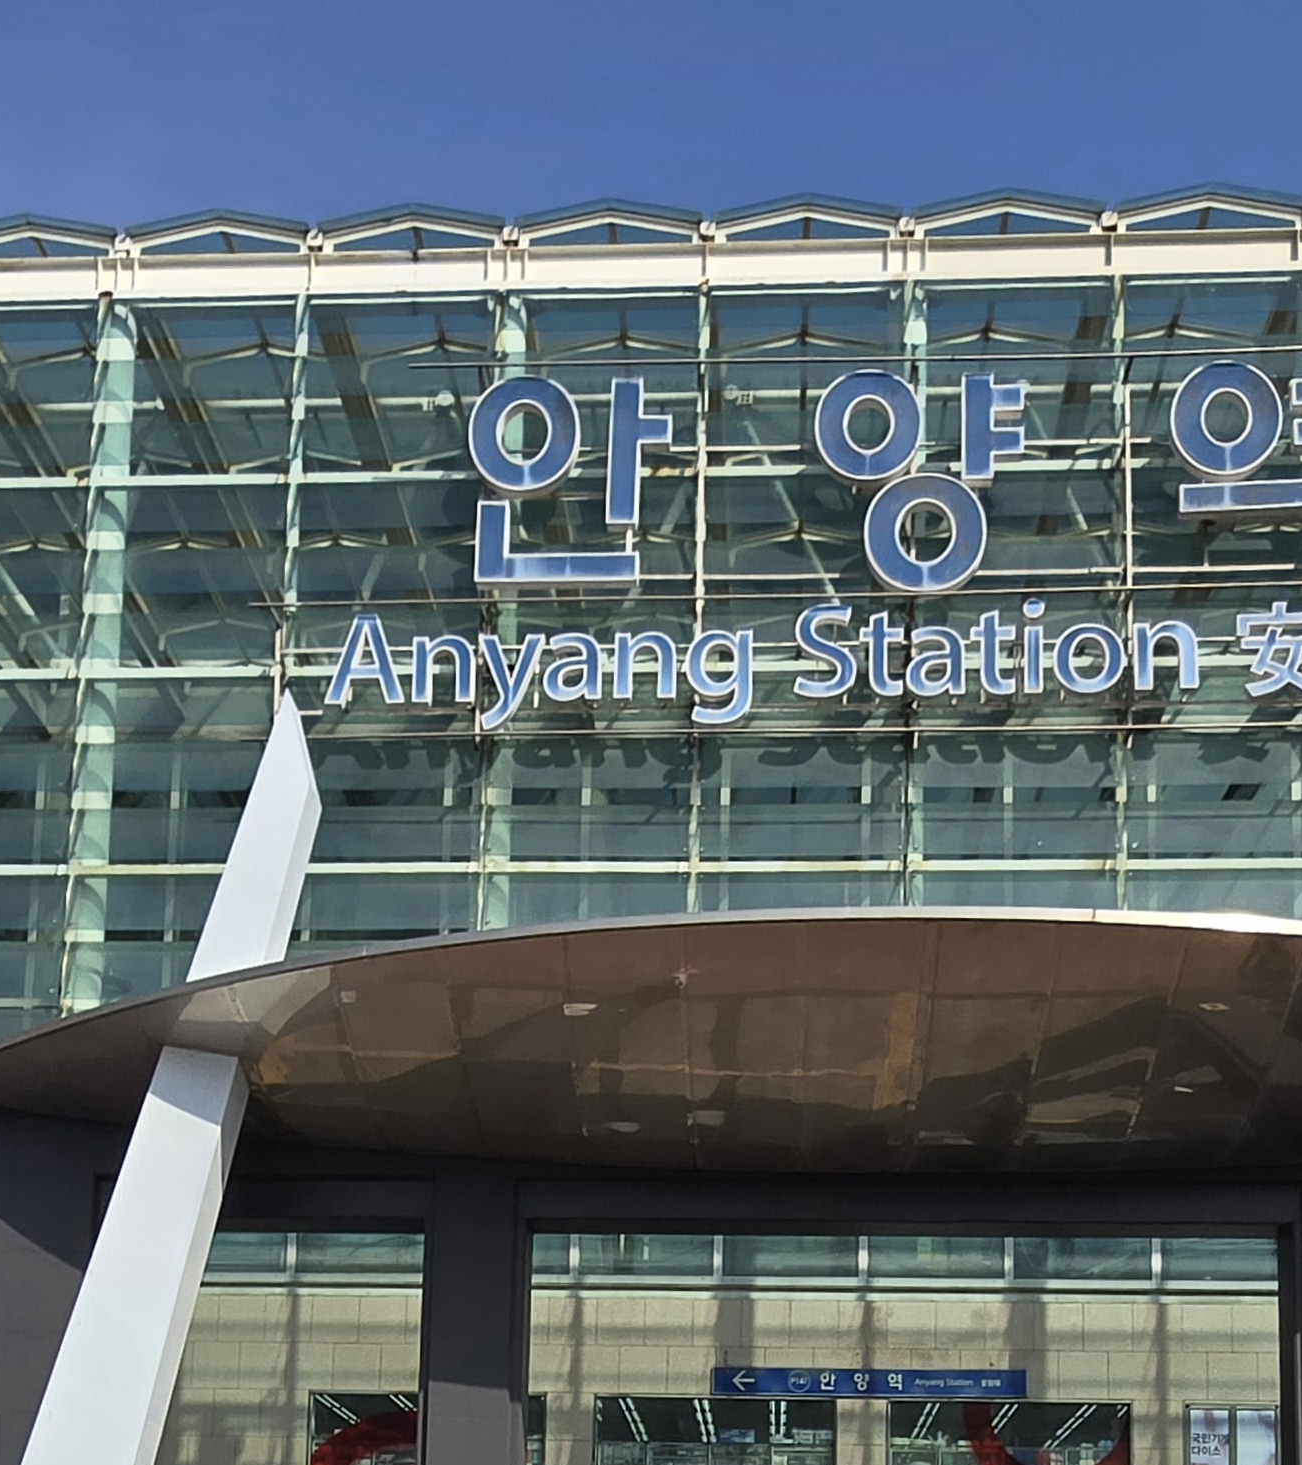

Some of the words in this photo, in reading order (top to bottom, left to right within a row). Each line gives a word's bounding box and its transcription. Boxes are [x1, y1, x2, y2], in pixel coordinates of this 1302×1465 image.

[326, 611, 753, 725] Anyang
[793, 600, 1200, 698] Station
[914, 1377, 945, 1388] Anyang
